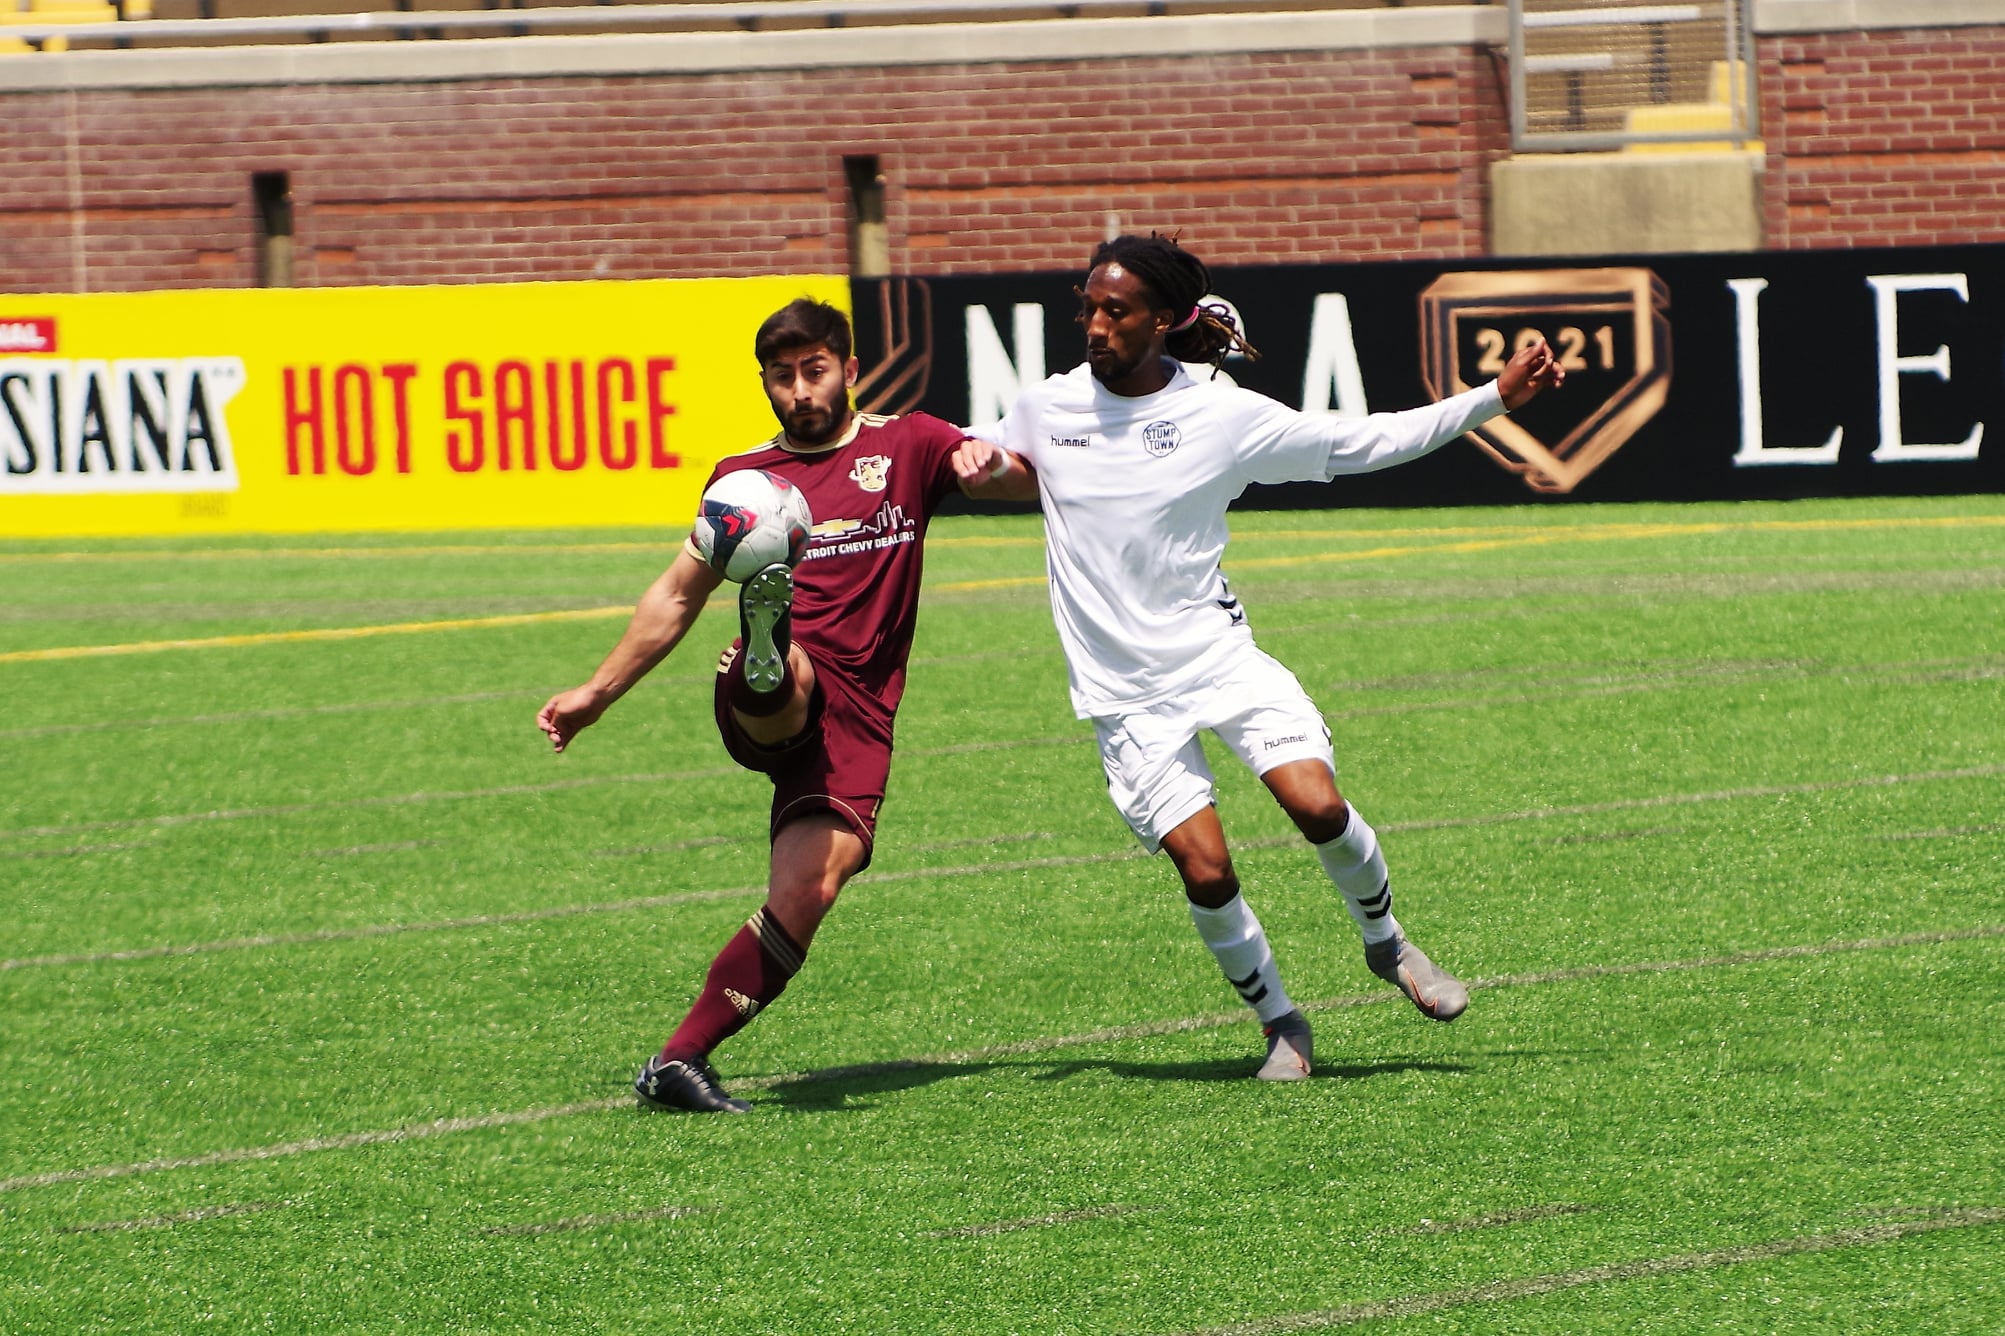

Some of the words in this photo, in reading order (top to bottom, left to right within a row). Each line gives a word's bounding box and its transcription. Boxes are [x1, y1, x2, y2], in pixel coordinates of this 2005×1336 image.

[282, 363, 418, 476] HOT
[444, 356, 680, 473] SAUCE
[1050, 434, 1091, 447] hummel
[1145, 427, 1176, 440] STUMP
[1148, 440, 1175, 451] TOWN
[803, 545, 837, 560] TROIT
[838, 539, 873, 554] CHEVY
[874, 531, 915, 548] DEALERS
[1263, 732, 1308, 751] hummel
